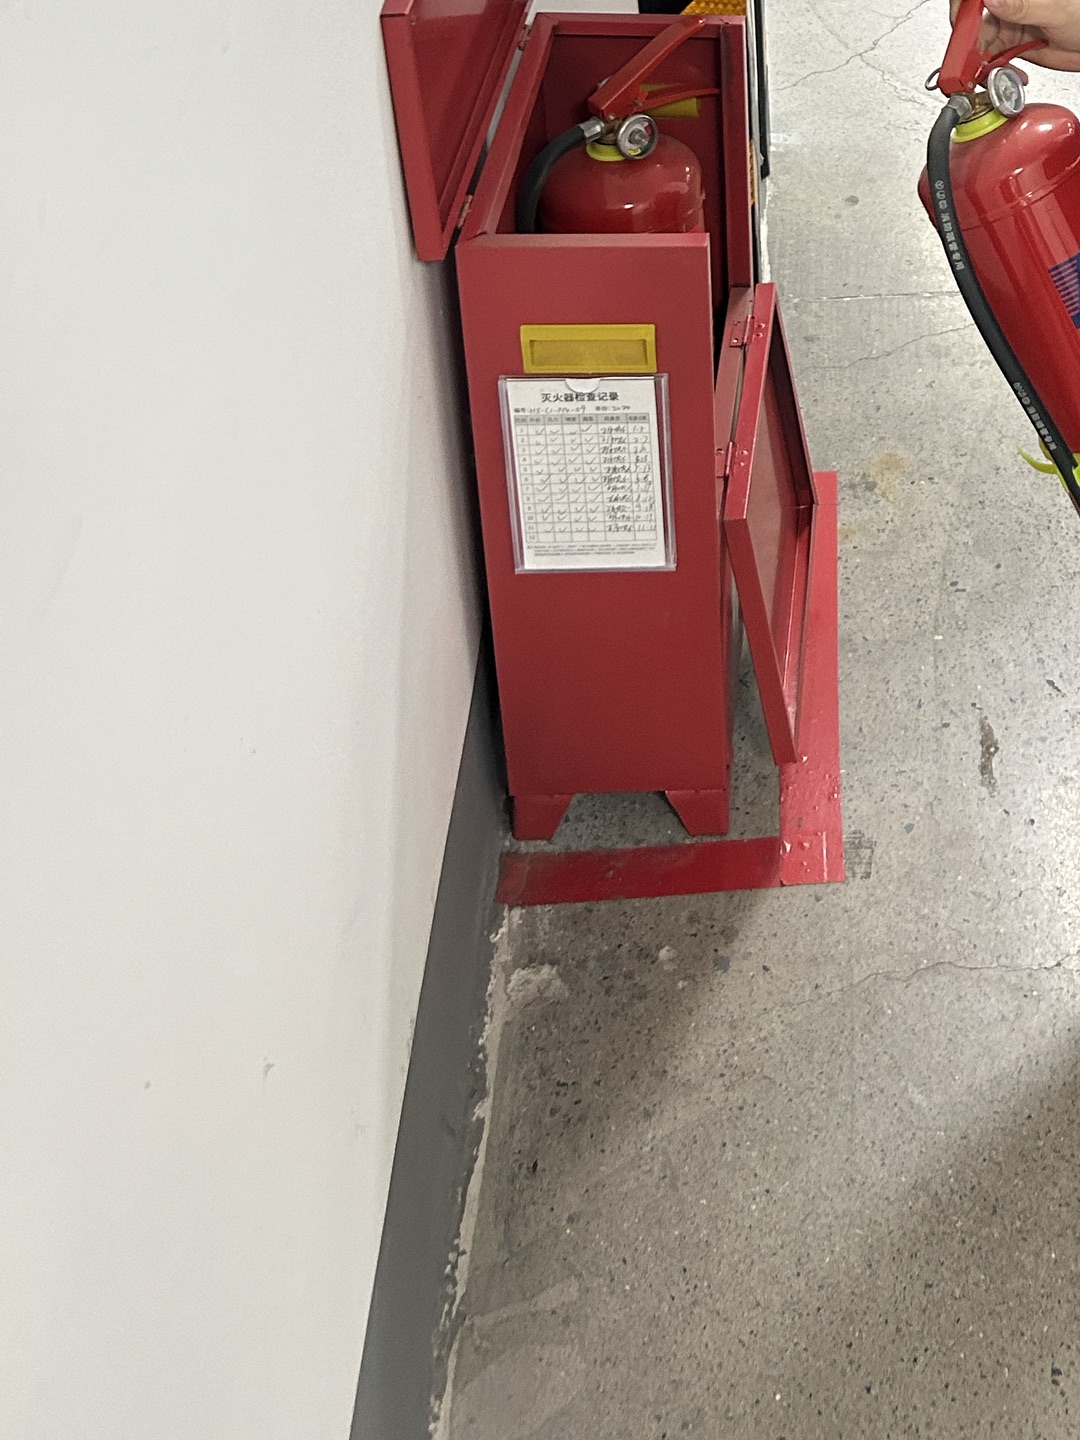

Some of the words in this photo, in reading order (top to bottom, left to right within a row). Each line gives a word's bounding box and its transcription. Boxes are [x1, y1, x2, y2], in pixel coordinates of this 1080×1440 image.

[541, 392, 619, 403] 灭火器检查记录
